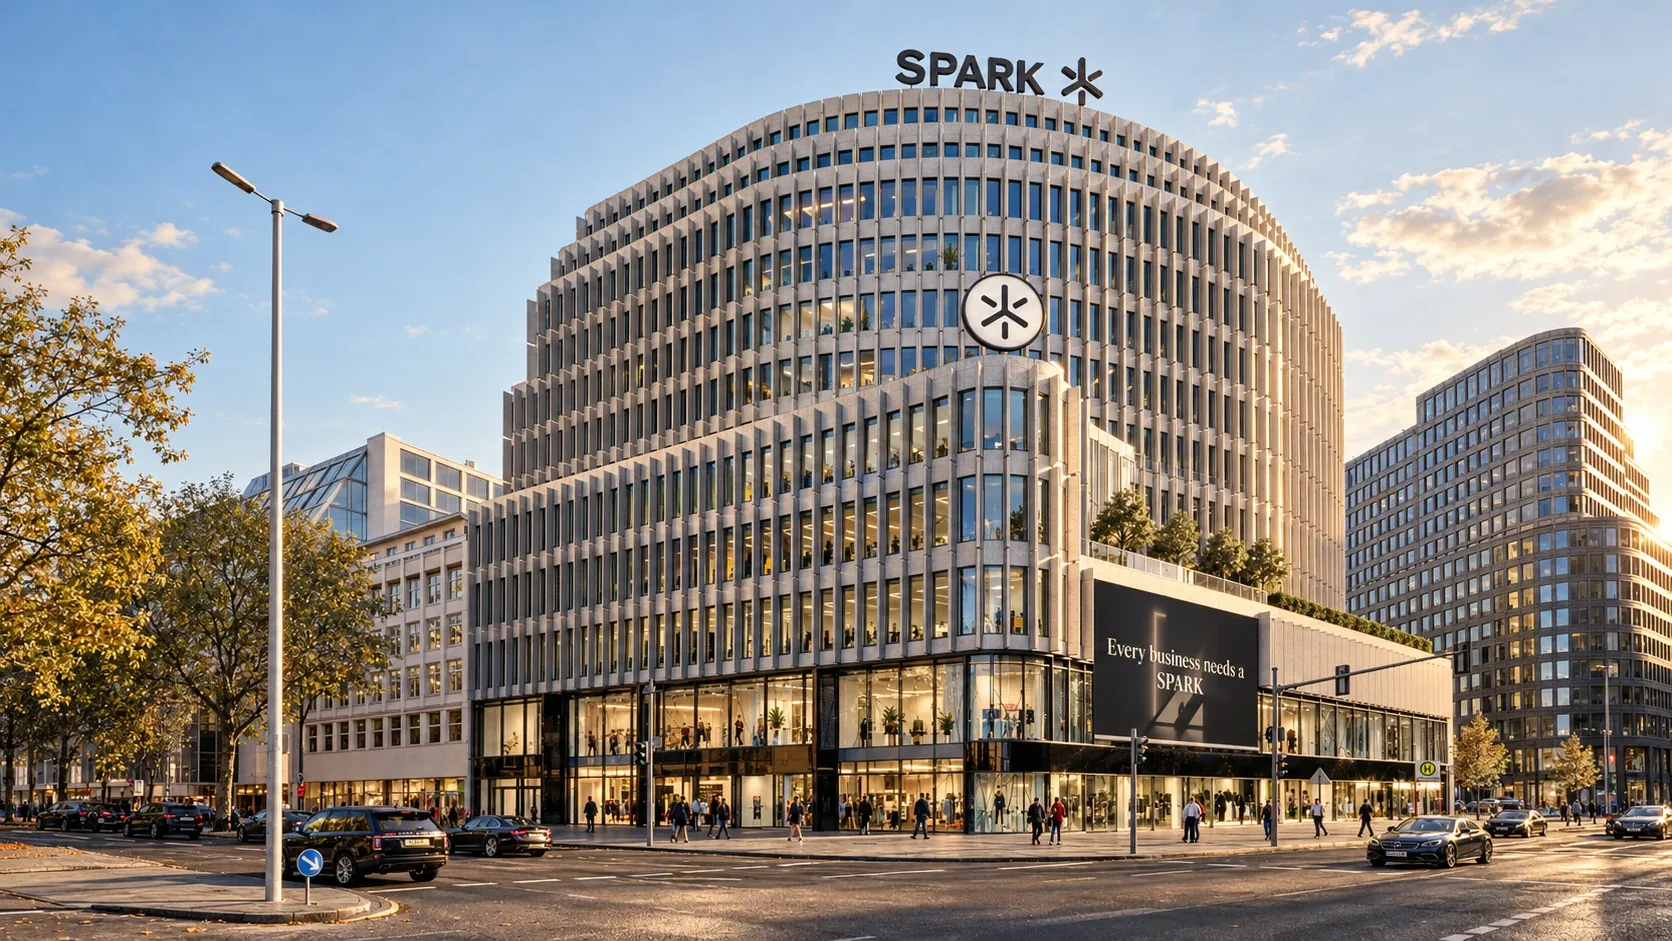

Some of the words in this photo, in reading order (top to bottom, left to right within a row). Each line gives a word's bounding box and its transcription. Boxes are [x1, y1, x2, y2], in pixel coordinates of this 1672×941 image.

[895, 49, 1044, 95] SPARK
[1107, 637, 1146, 665] Every
[1150, 645, 1201, 670] business
[1204, 660, 1235, 677] needs
[1238, 667, 1245, 679] a
[1157, 672, 1204, 695] SPARK
[1423, 764, 1432, 773] H
